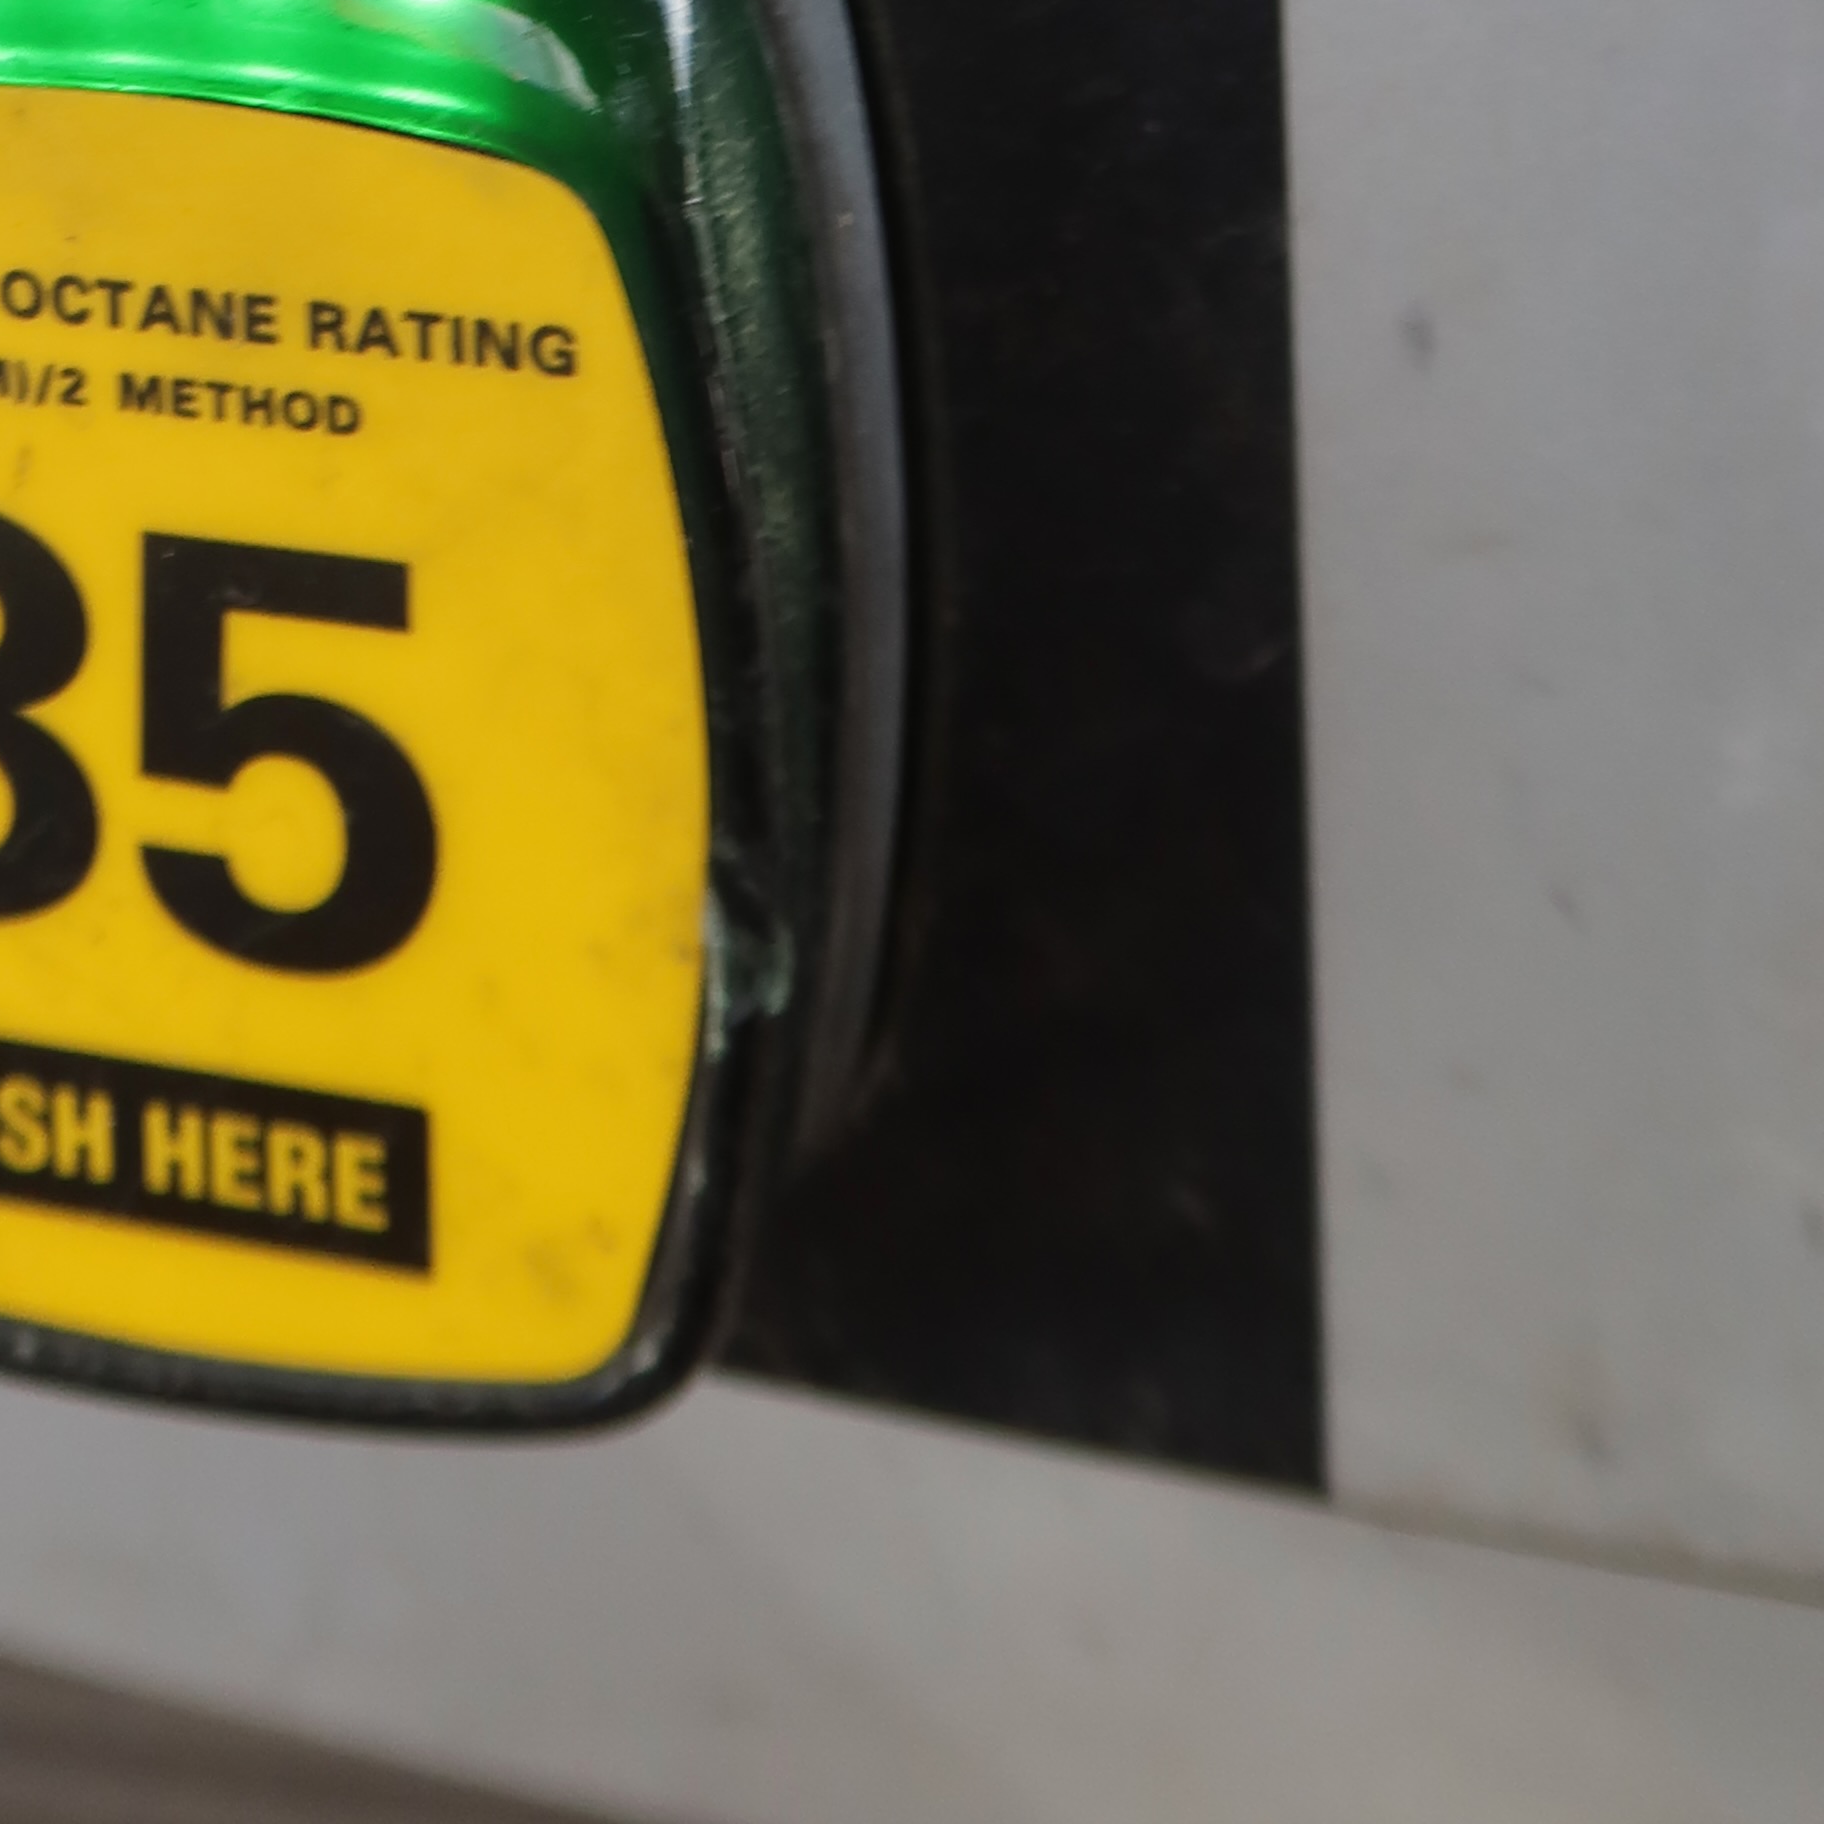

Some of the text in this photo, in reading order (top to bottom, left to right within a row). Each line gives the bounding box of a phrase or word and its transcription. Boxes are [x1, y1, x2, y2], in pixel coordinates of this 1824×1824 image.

[0, 269, 279, 344] OCTANE
[308, 300, 578, 377] RATING
[119, 372, 362, 435] METHOD
[143, 1098, 387, 1230] HERE
